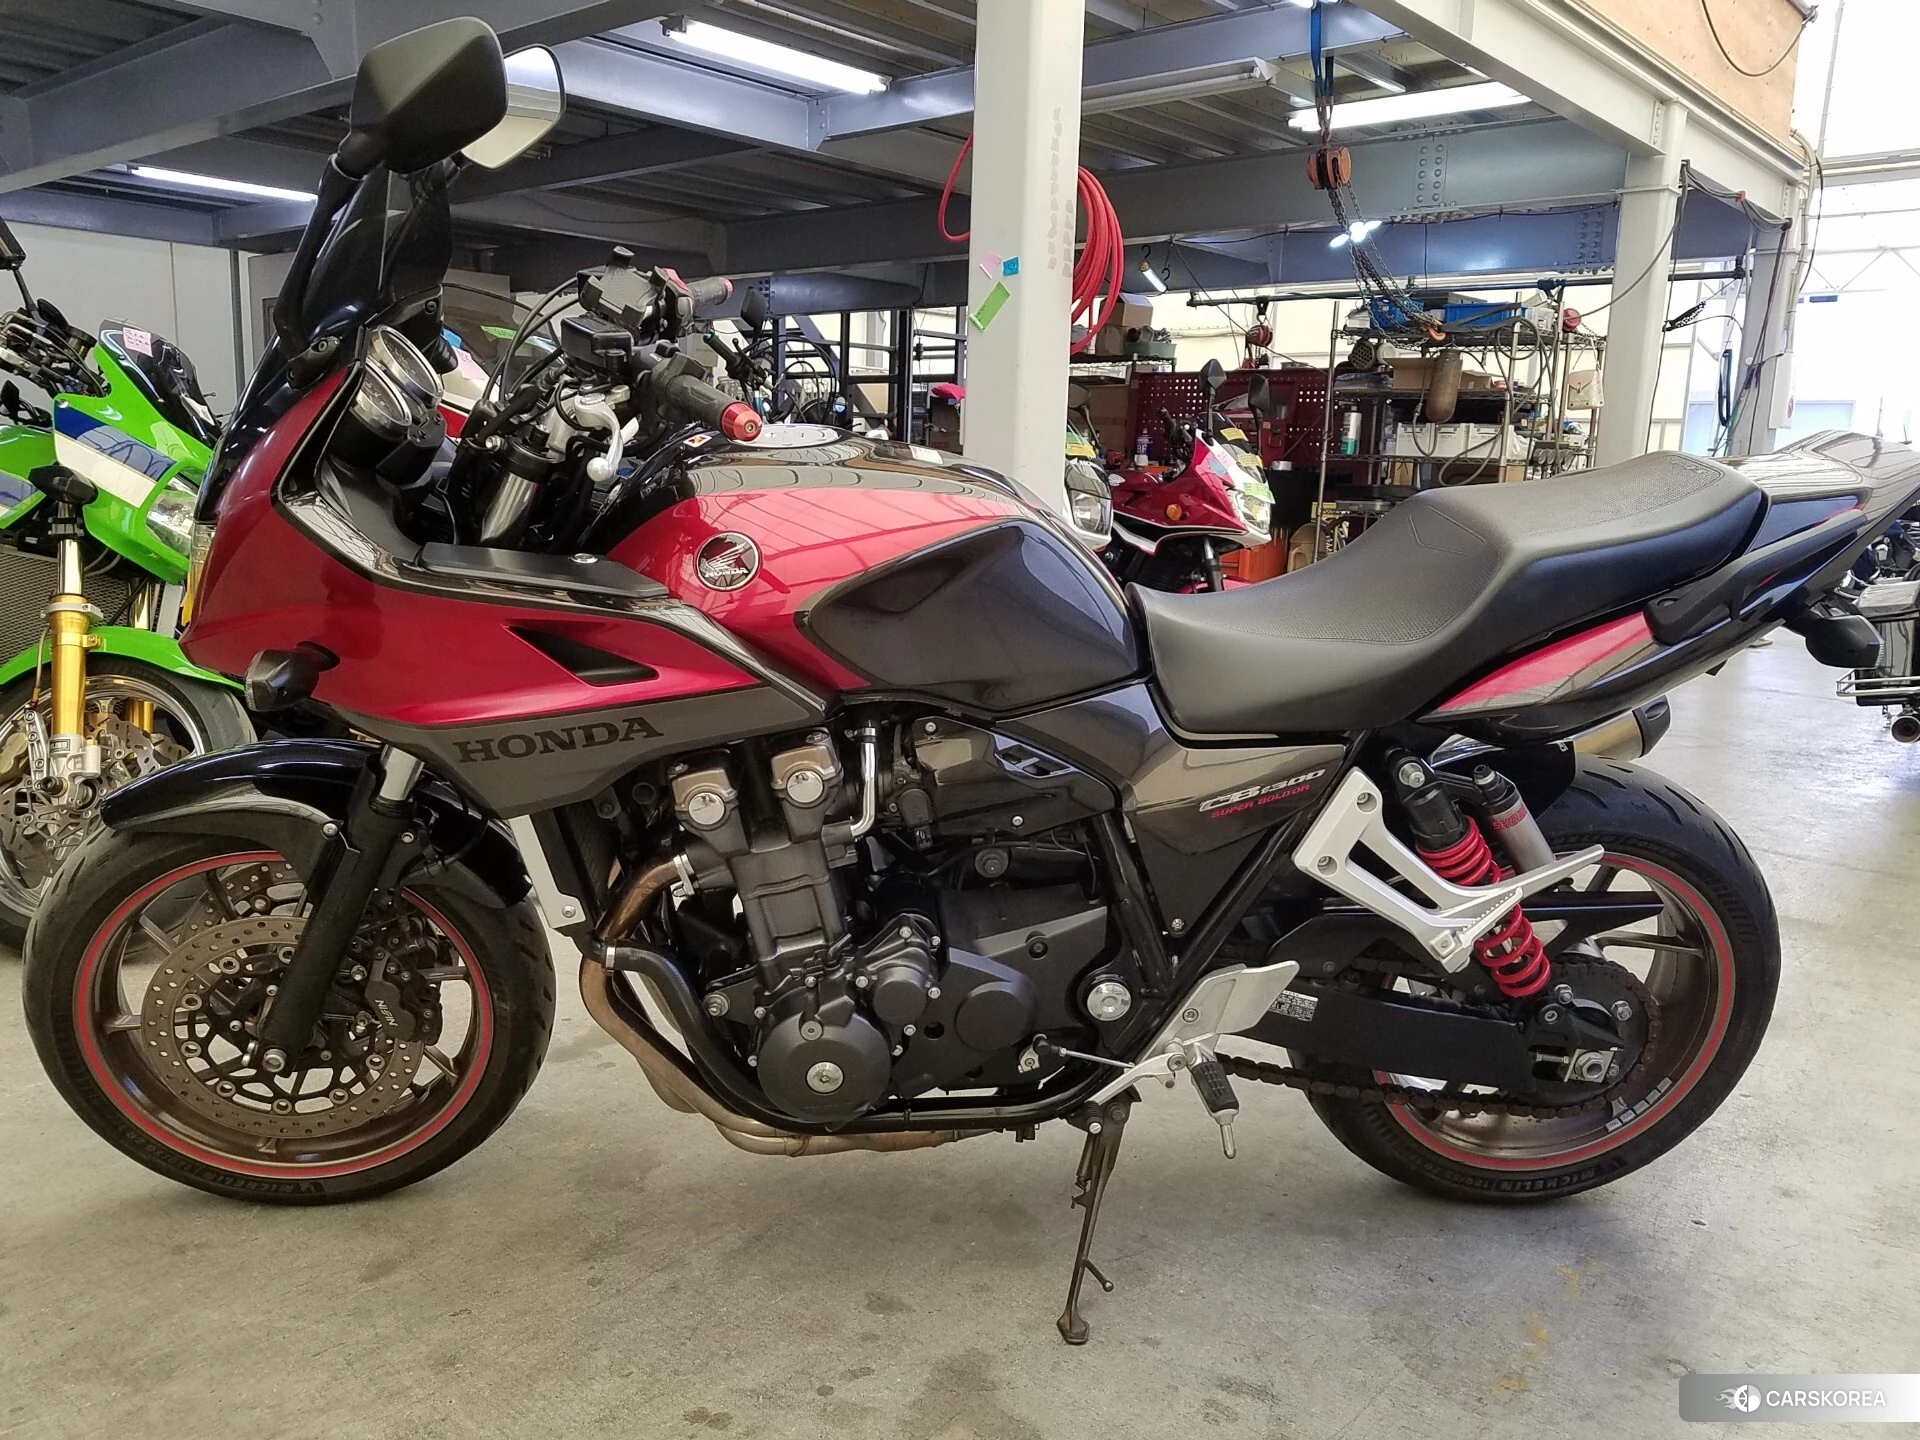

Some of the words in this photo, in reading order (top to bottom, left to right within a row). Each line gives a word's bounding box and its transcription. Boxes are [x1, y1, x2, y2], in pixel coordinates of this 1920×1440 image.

[704, 567, 749, 578] HONDA
[453, 716, 664, 763] HONDA
[1211, 801, 1254, 818] SUPER
[1493, 803, 1528, 830] SHOW
[374, 999, 398, 1027] NISSIN
[1499, 1167, 1597, 1192] MICHELIN
